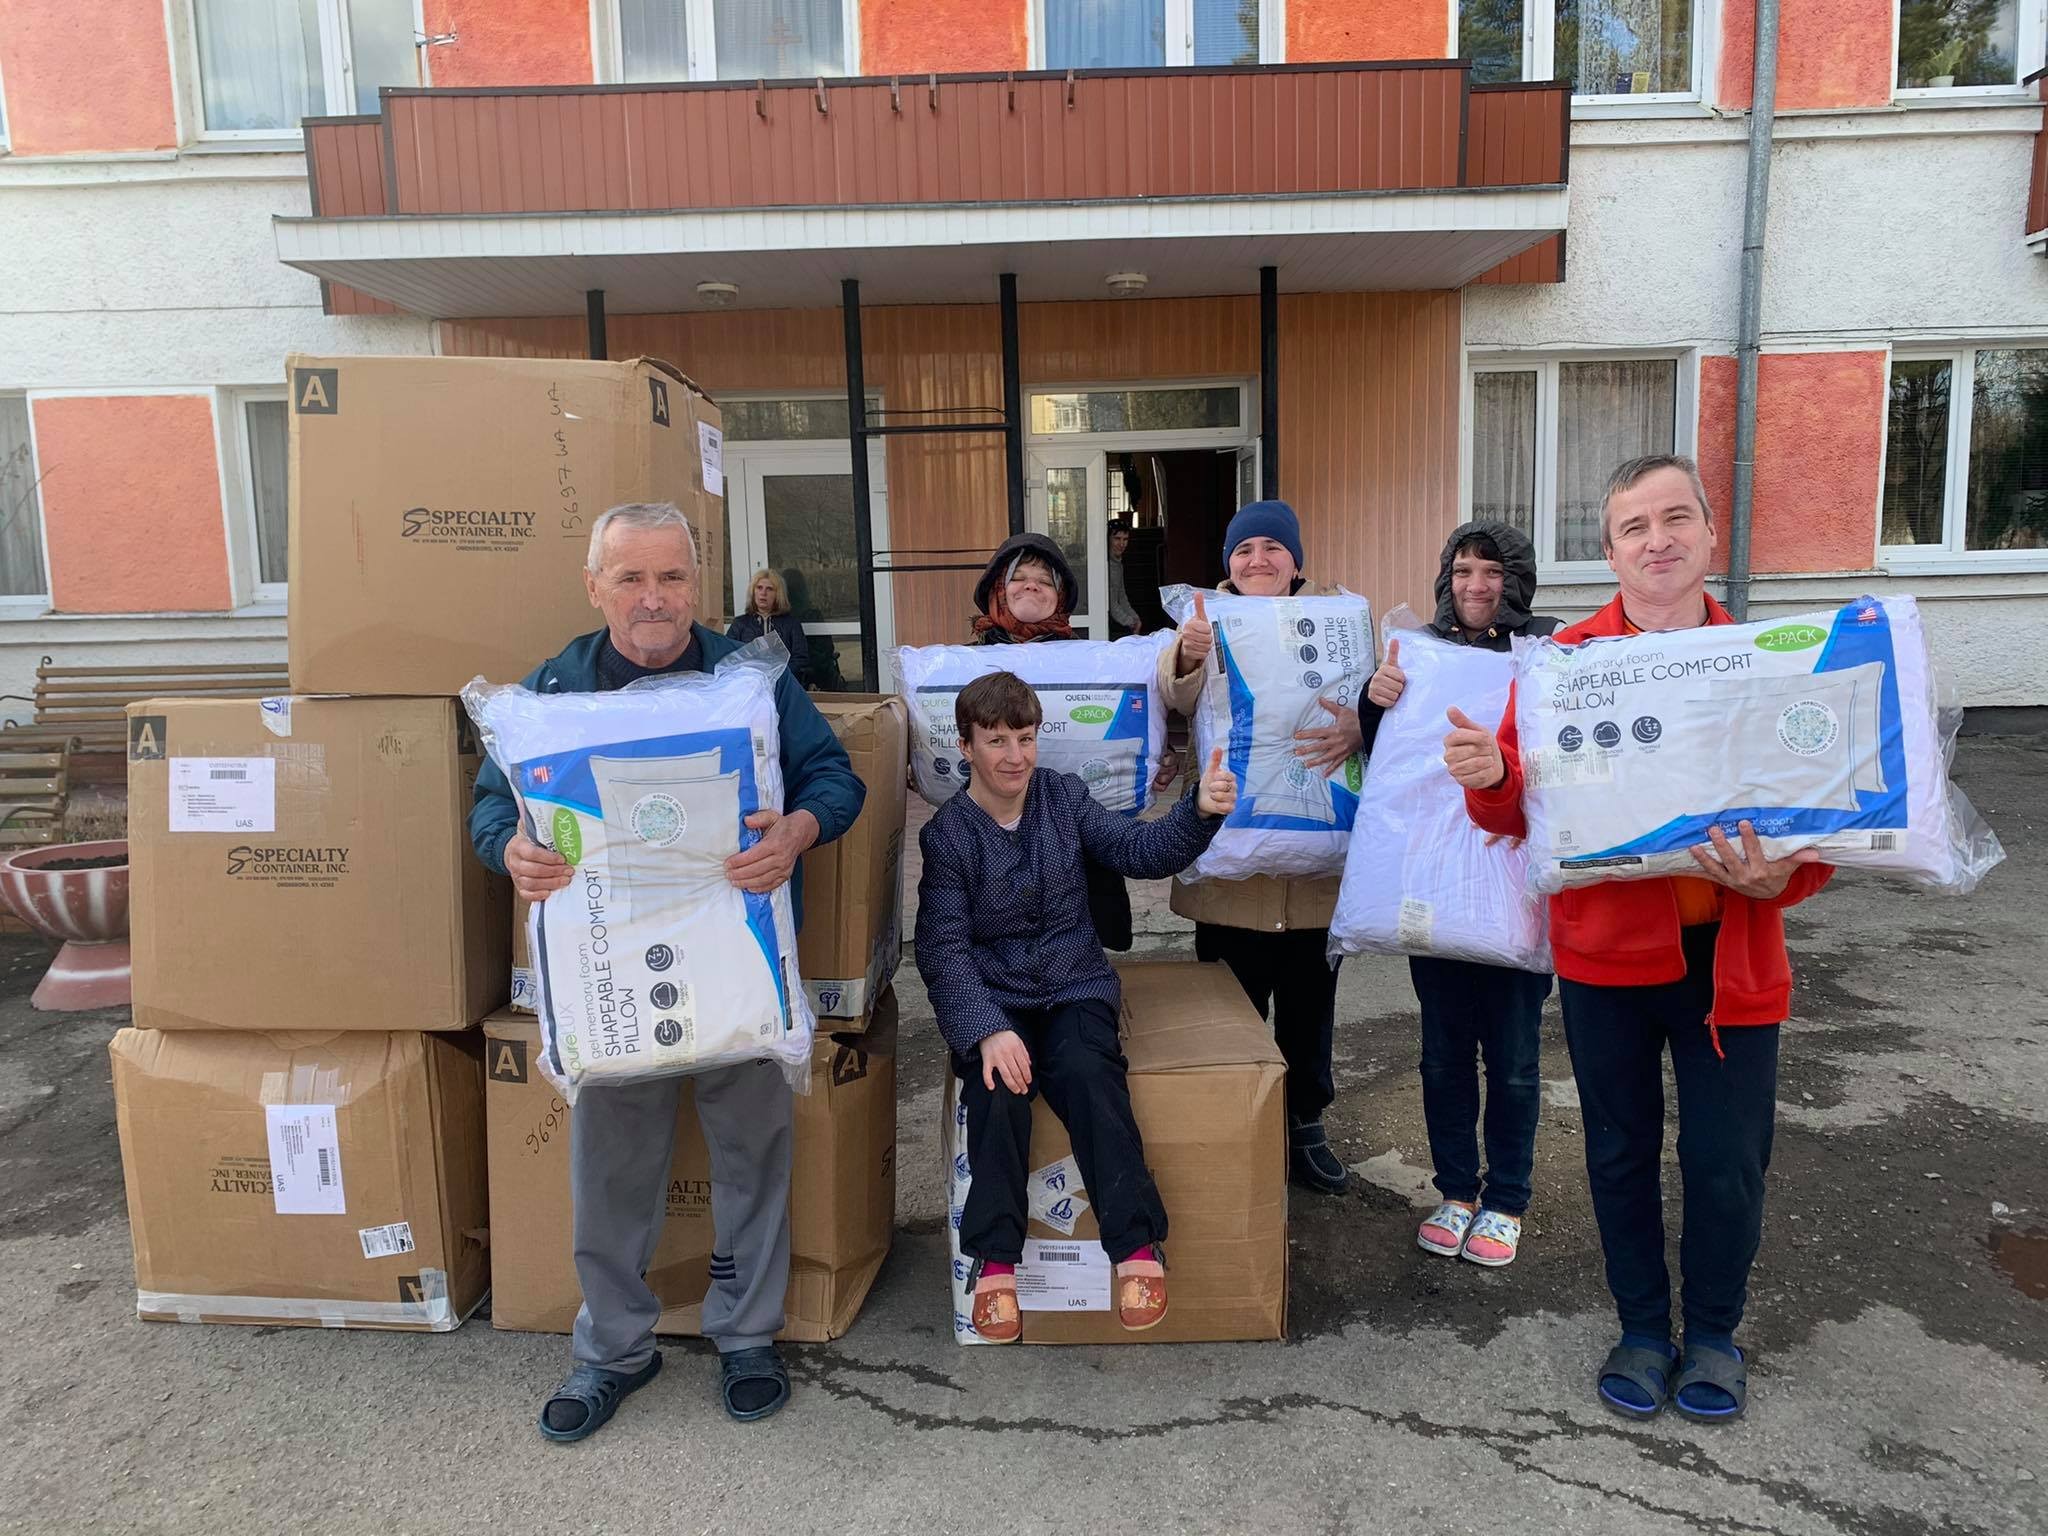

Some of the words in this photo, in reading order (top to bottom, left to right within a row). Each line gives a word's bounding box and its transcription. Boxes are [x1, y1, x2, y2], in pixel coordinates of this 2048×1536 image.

[301, 375, 329, 407] A
[656, 386, 668, 419] A
[431, 510, 537, 526] SPECIALTY
[431, 526, 508, 539] CONTAINER,
[510, 527, 537, 538] INC.
[1324, 617, 1338, 664] PILLOW
[1766, 628, 1818, 647] 2-PACK
[1626, 650, 1665, 666] foam
[1554, 668, 1646, 698] SHAPEABLE
[1651, 653, 1753, 682] COMFORT
[1064, 694, 1092, 702] QUEEN
[1553, 691, 1615, 714] PILLOW
[1076, 709, 1109, 719] 2-PACK
[137, 722, 159, 753] A
[235, 820, 253, 828] UAS
[558, 814, 577, 858] 2-PACK
[254, 848, 350, 863] SPECIALTY
[254, 863, 323, 874] CONTAINER,
[326, 864, 350, 874] INC.
[584, 868, 610, 955] COMFORT
[578, 942, 591, 979] foam
[582, 981, 599, 1039] memory
[595, 960, 621, 1057] SHAPEABLE
[618, 988, 641, 1055] PILLOW
[494, 1045, 519, 1076] A
[587, 1042, 604, 1060] gel
[839, 1049, 860, 1078] A
[526, 1098, 569, 1154] 5696
[208, 1168, 229, 1178] INC.
[276, 1174, 286, 1192] UAS
[211, 1179, 274, 1195] ECIALTY
[694, 1196, 711, 1205] INC
[1068, 1299, 1087, 1307] UAS
